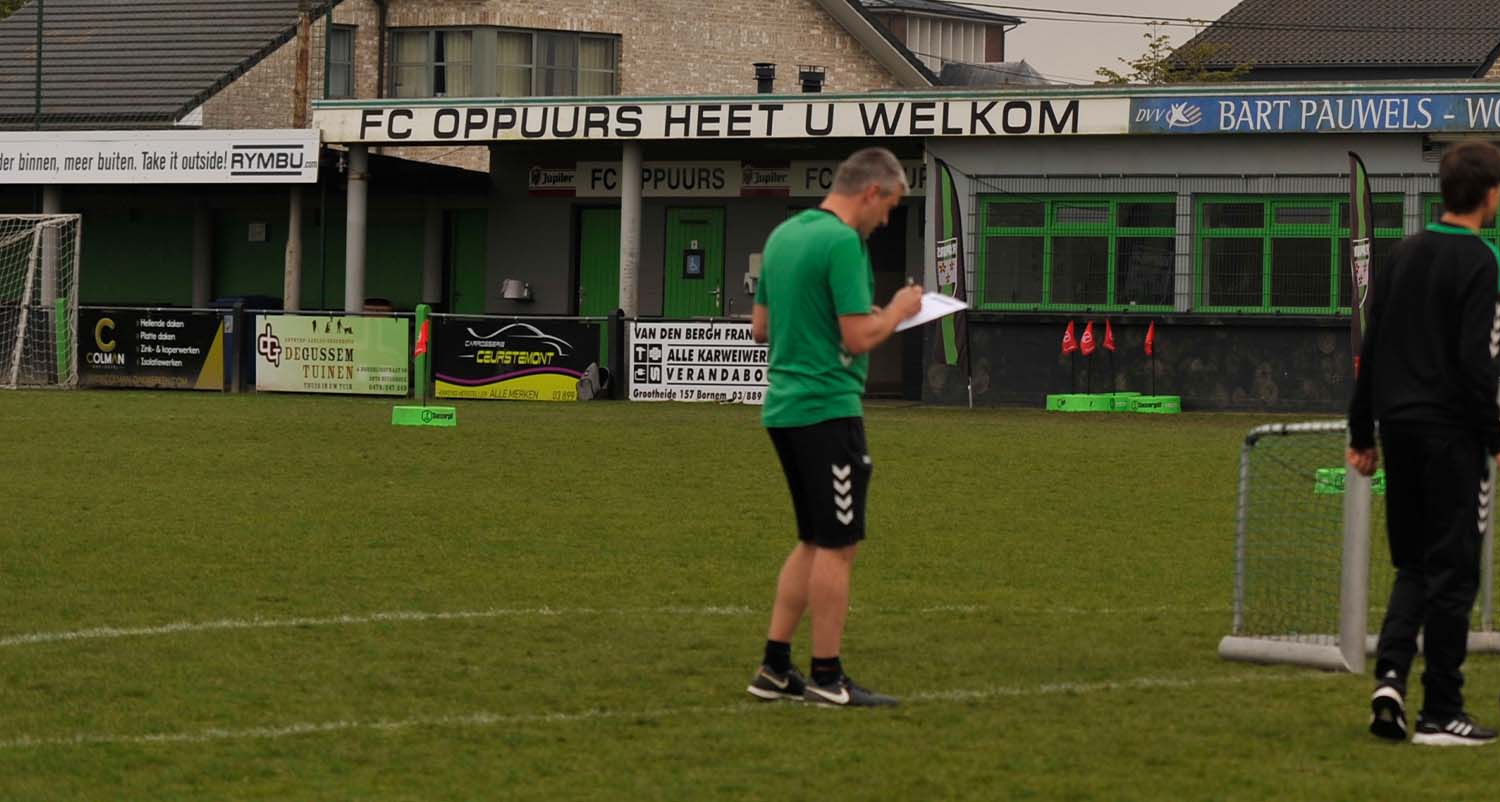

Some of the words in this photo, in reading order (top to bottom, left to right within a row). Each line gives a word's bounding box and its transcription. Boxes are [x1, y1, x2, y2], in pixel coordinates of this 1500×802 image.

[360, 109, 413, 140] FC
[433, 105, 643, 139] OPPUURS
[664, 104, 784, 137] HEET
[806, 104, 835, 136] U
[859, 100, 1080, 135] WELKOM
[1136, 108, 1166, 123] DVV
[1218, 100, 1290, 130] BART
[1300, 98, 1432, 130] PAUWELS
[18, 152, 60, 174] binnen,
[64, 154, 94, 171] meer
[97, 152, 137, 171] buiten.
[141, 151, 166, 170] Take
[169, 151, 179, 170] it
[181, 151, 228, 170] outside!
[591, 168, 617, 190] FC
[642, 167, 725, 190] PPUURS
[805, 168, 832, 189] FC
[166, 319, 185, 328] daken
[140, 332, 157, 340] Platte
[158, 332, 176, 341] daken
[634, 327, 656, 339] VAN
[660, 328, 682, 340] DEN
[685, 328, 721, 340] BERGH
[725, 328, 753, 340] FRAN
[162, 345, 200, 355] koperwerken
[285, 346, 354, 362] DEGUSSEM
[476, 350, 556, 365] CEURSTEMONT
[667, 348, 694, 362] ALLE
[698, 349, 769, 363] KARWEIWER
[86, 352, 125, 365] COLMAN
[140, 358, 183, 367] Isolatiewerken
[303, 365, 354, 380] TUINEN
[666, 368, 763, 382] VERANDABO
[509, 390, 540, 400] MERKEN
[633, 388, 677, 400] Grootheide
[680, 390, 694, 399] 157
[697, 390, 727, 400] Bornem
